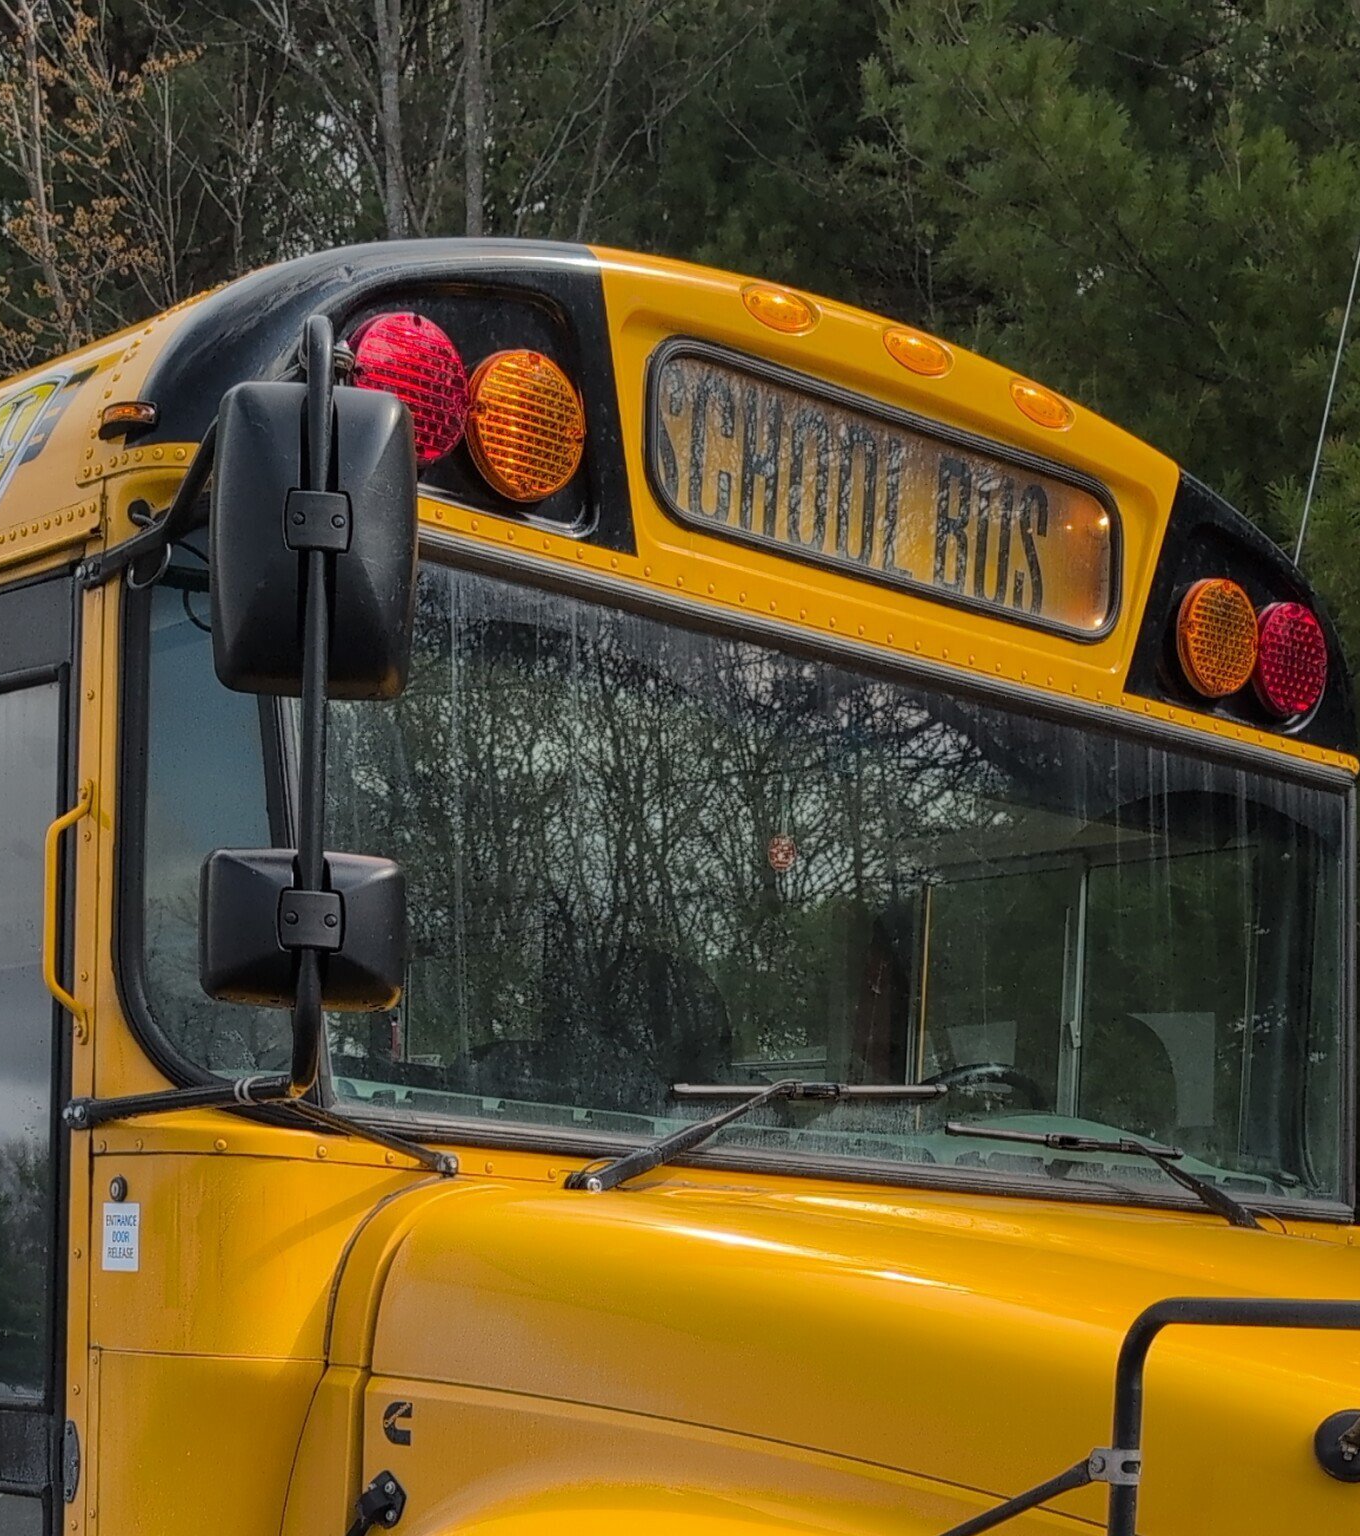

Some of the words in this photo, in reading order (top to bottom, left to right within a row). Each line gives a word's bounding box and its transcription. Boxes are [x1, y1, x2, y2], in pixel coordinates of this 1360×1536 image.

[934, 455, 1050, 615] BUS
[105, 1214, 137, 1227] ENTRANCE
[111, 1230, 130, 1243] DOOR
[107, 1246, 134, 1259] RELEASE
